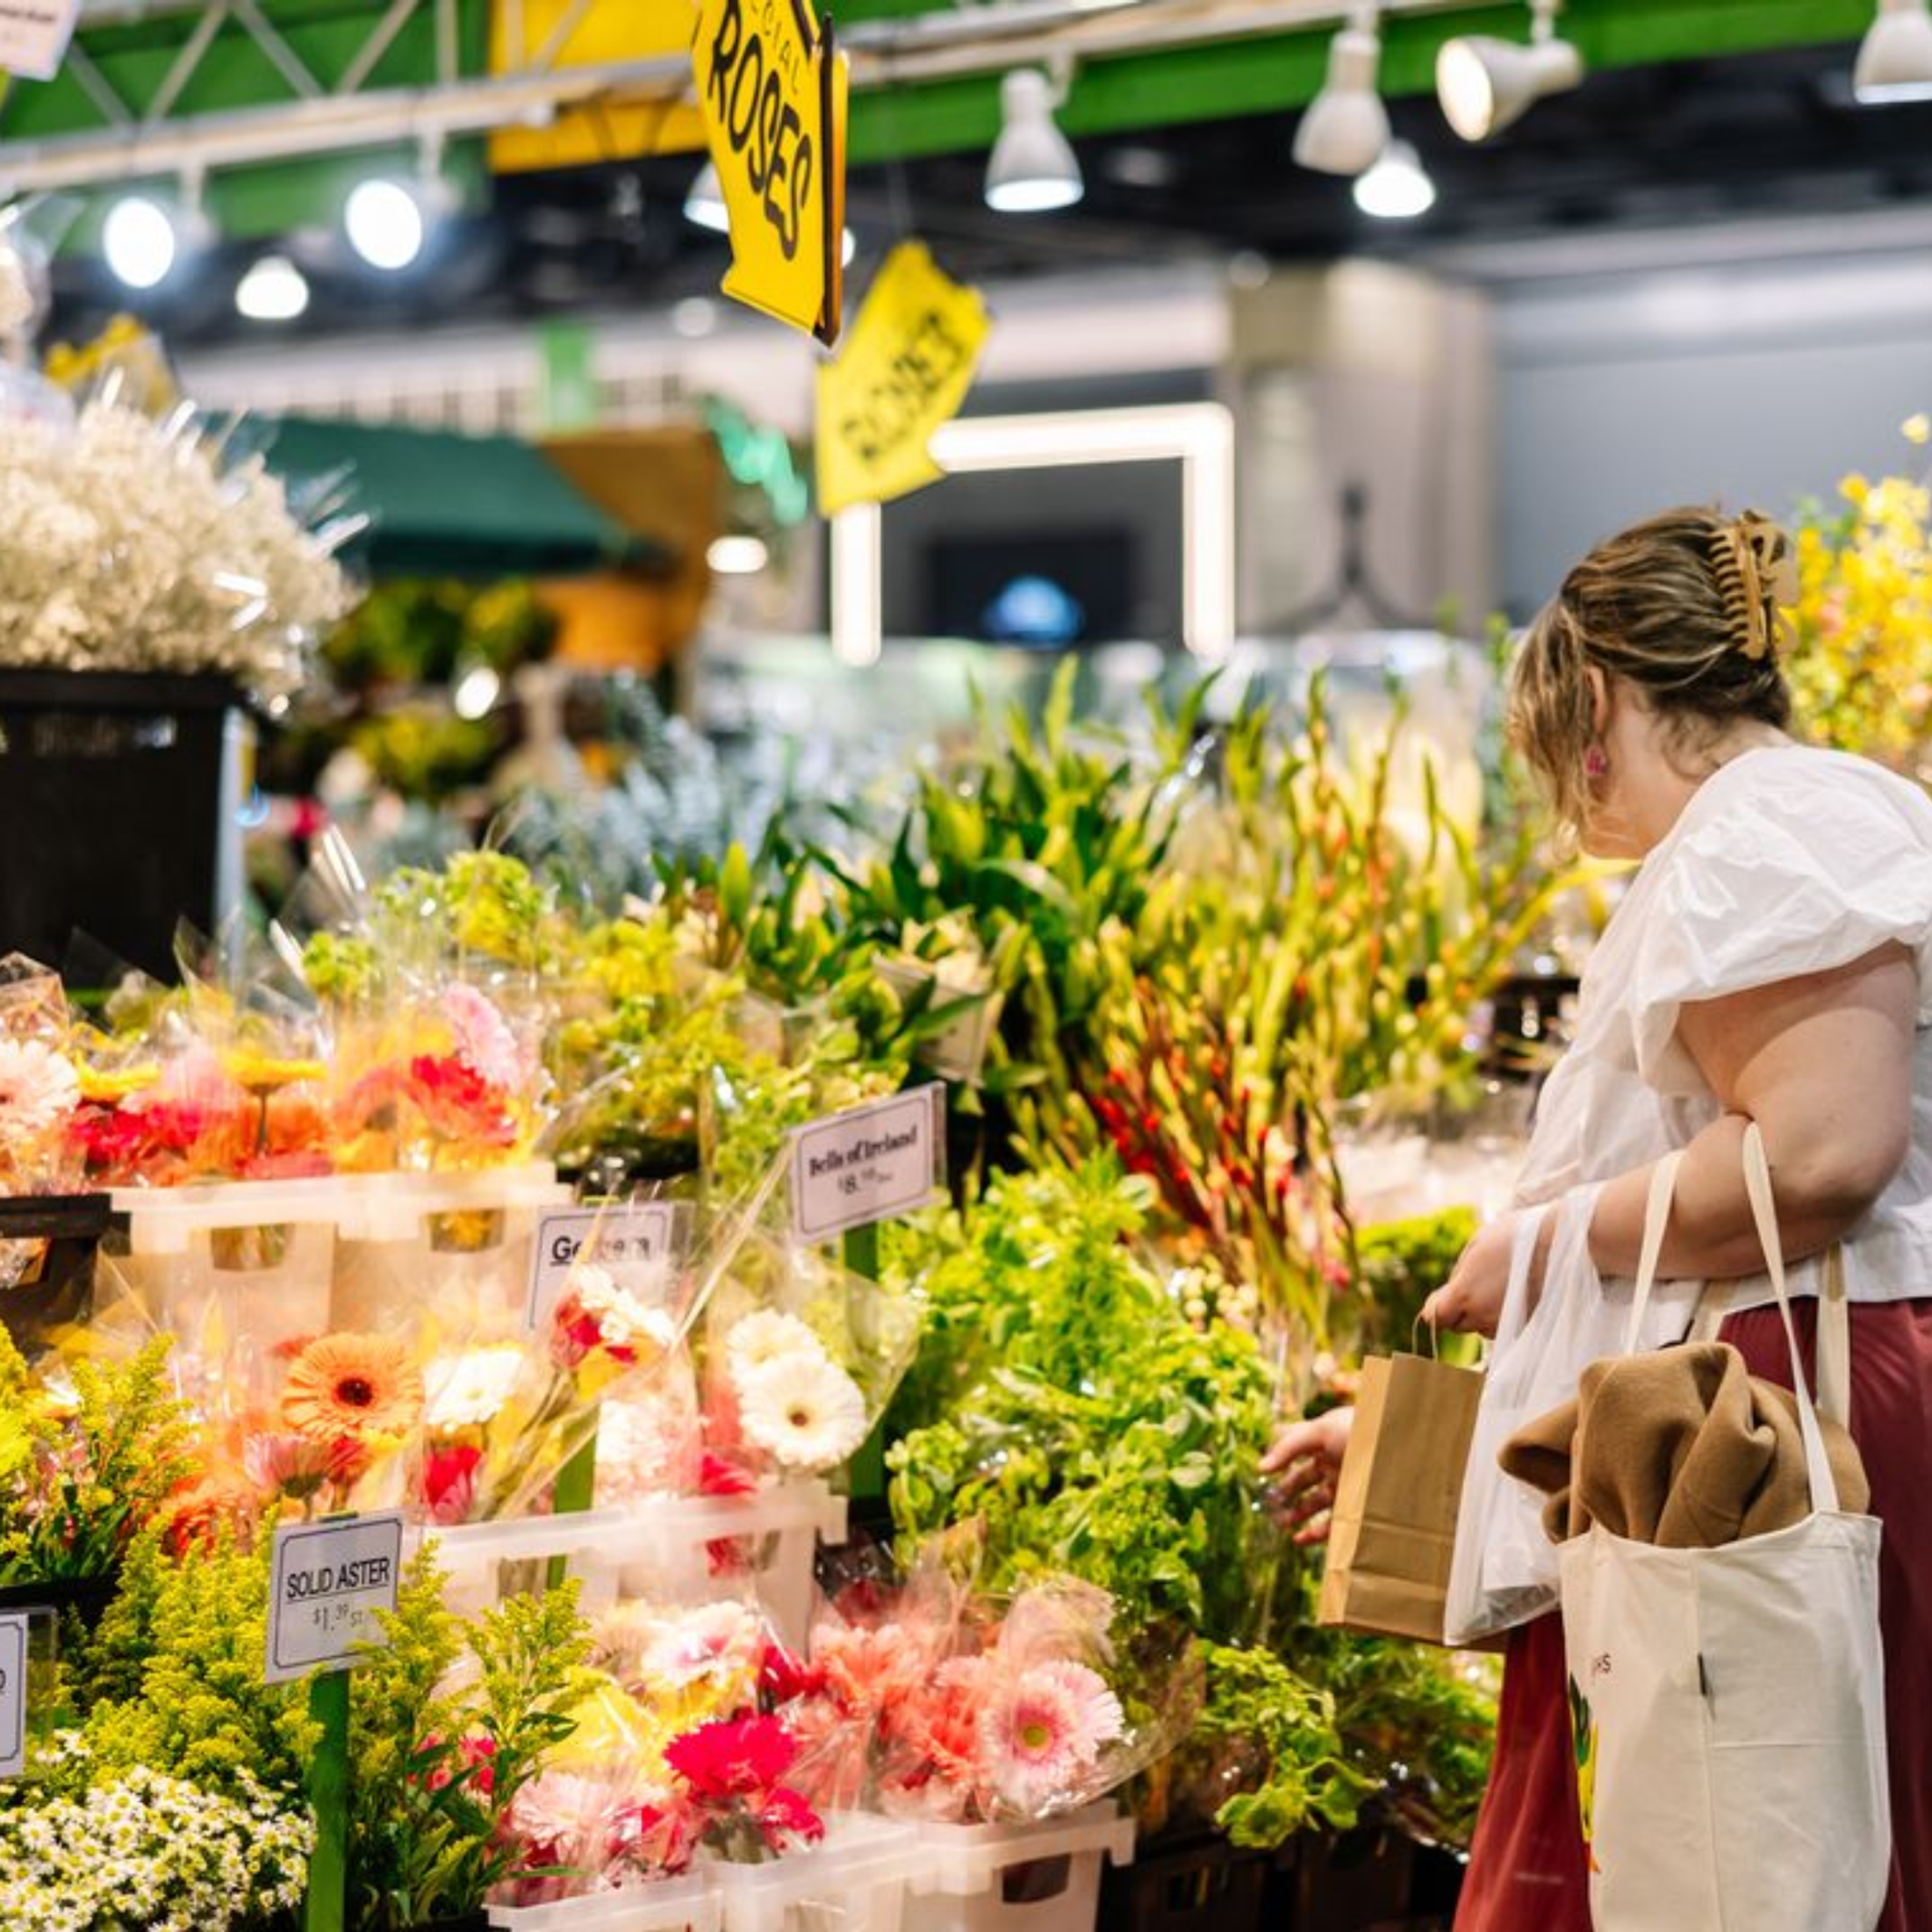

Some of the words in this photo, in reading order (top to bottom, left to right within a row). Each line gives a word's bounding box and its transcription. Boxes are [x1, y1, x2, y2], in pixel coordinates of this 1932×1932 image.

[707, 0, 812, 261] ROSES
[809, 1149, 844, 1177] Bells
[846, 1140, 865, 1163] of
[865, 1124, 917, 1159] Ireland
[287, 1568, 333, 1598] SOLID
[336, 1556, 390, 1589] ASTER
